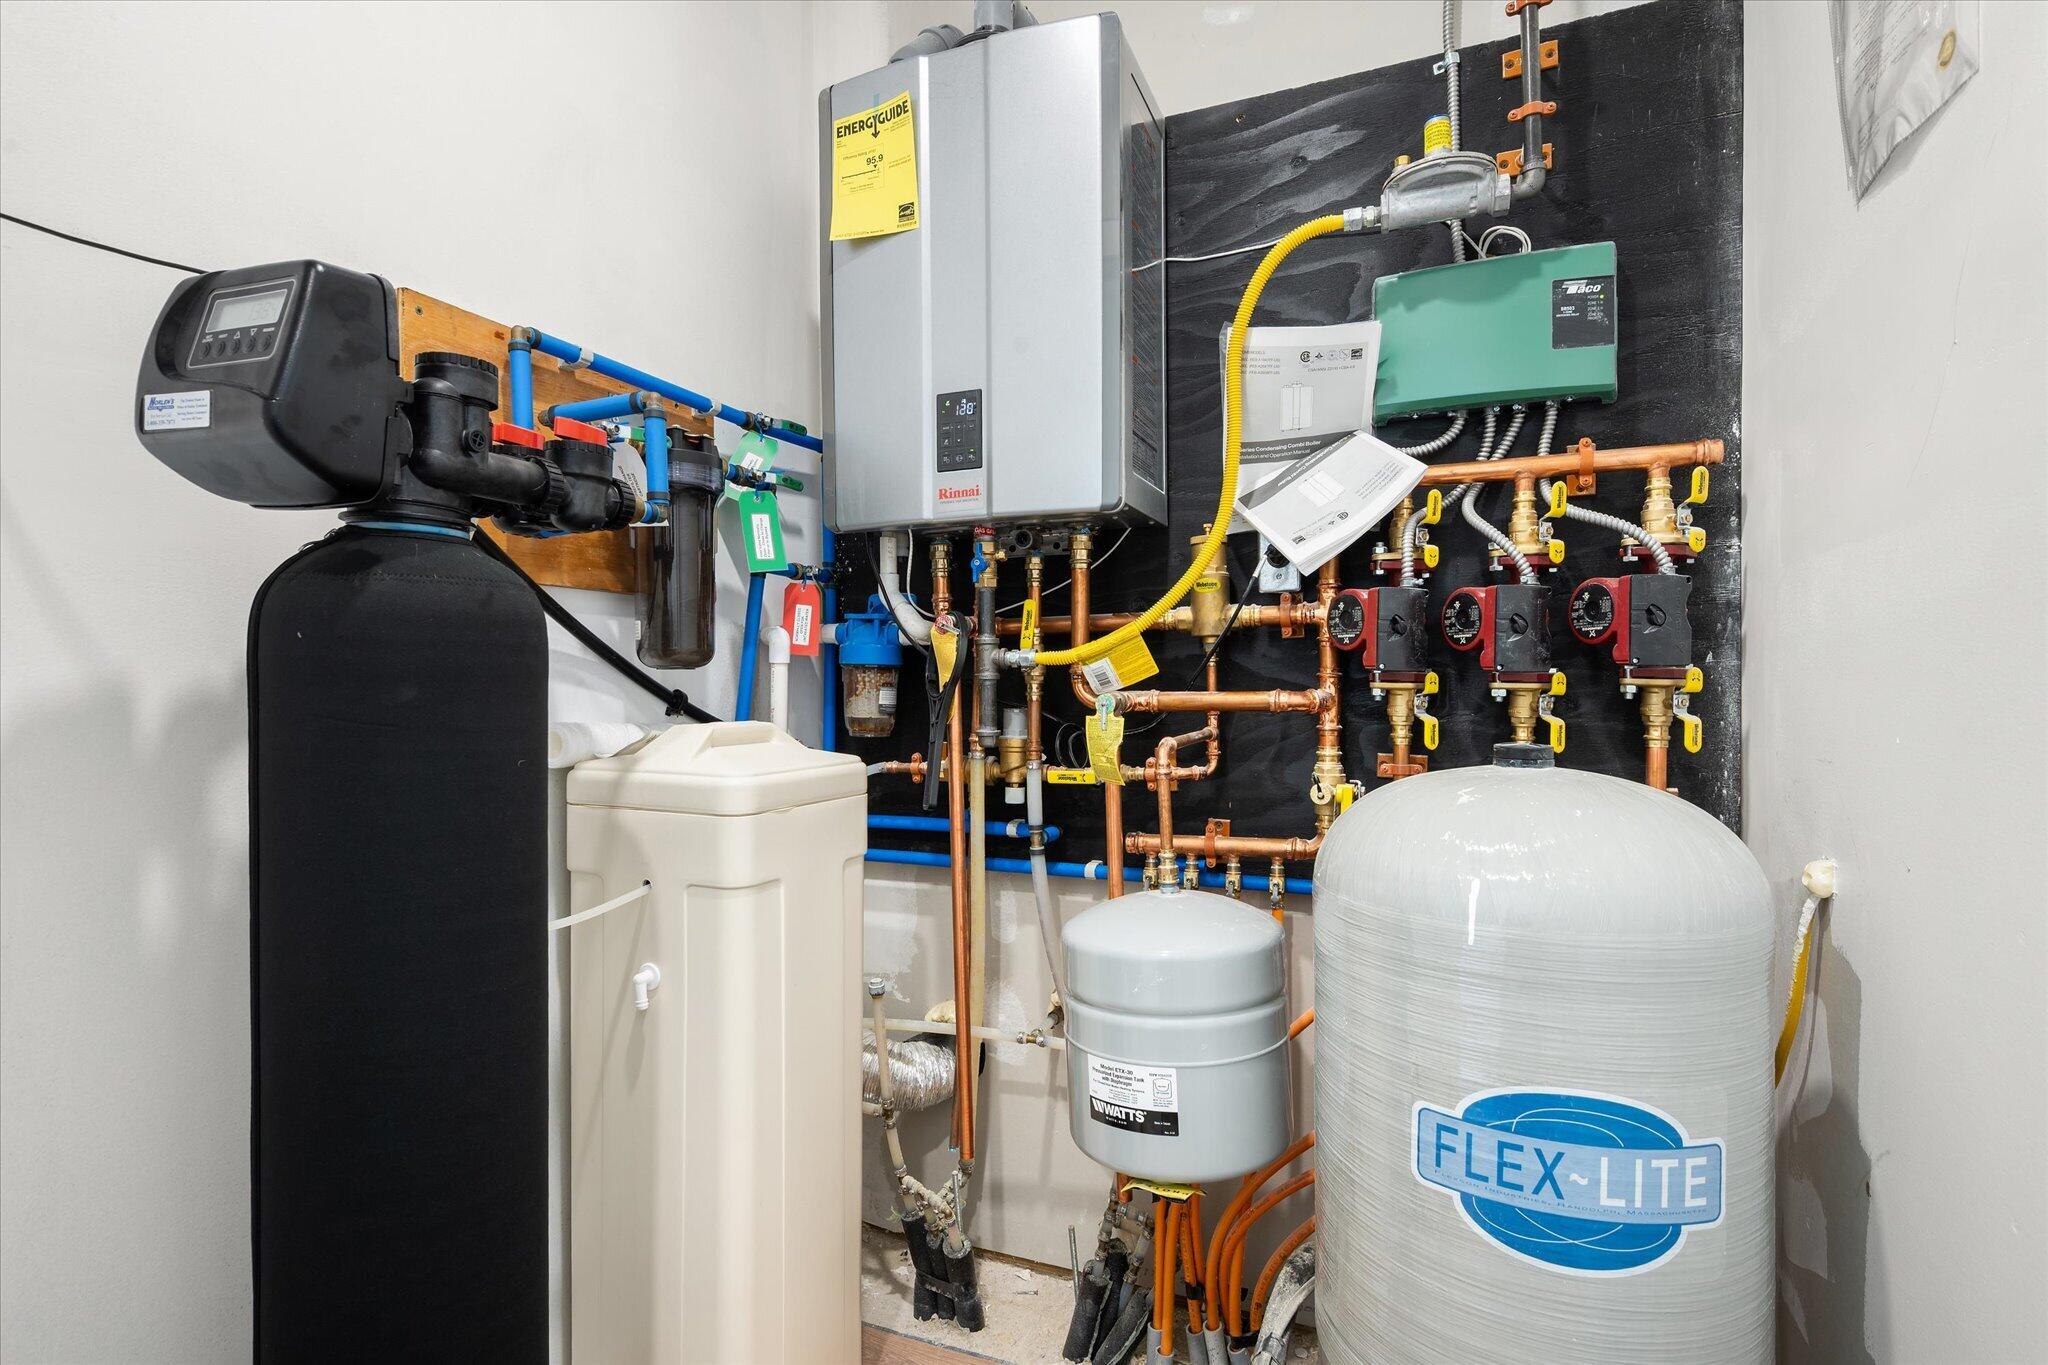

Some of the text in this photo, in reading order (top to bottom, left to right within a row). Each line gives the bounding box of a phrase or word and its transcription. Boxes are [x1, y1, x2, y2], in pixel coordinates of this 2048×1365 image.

[866, 154, 884, 166] 95.9
[1256, 444, 1287, 452] Condensing
[938, 485, 981, 500] Rinnai
[1101, 1101, 1145, 1123] WATTS
